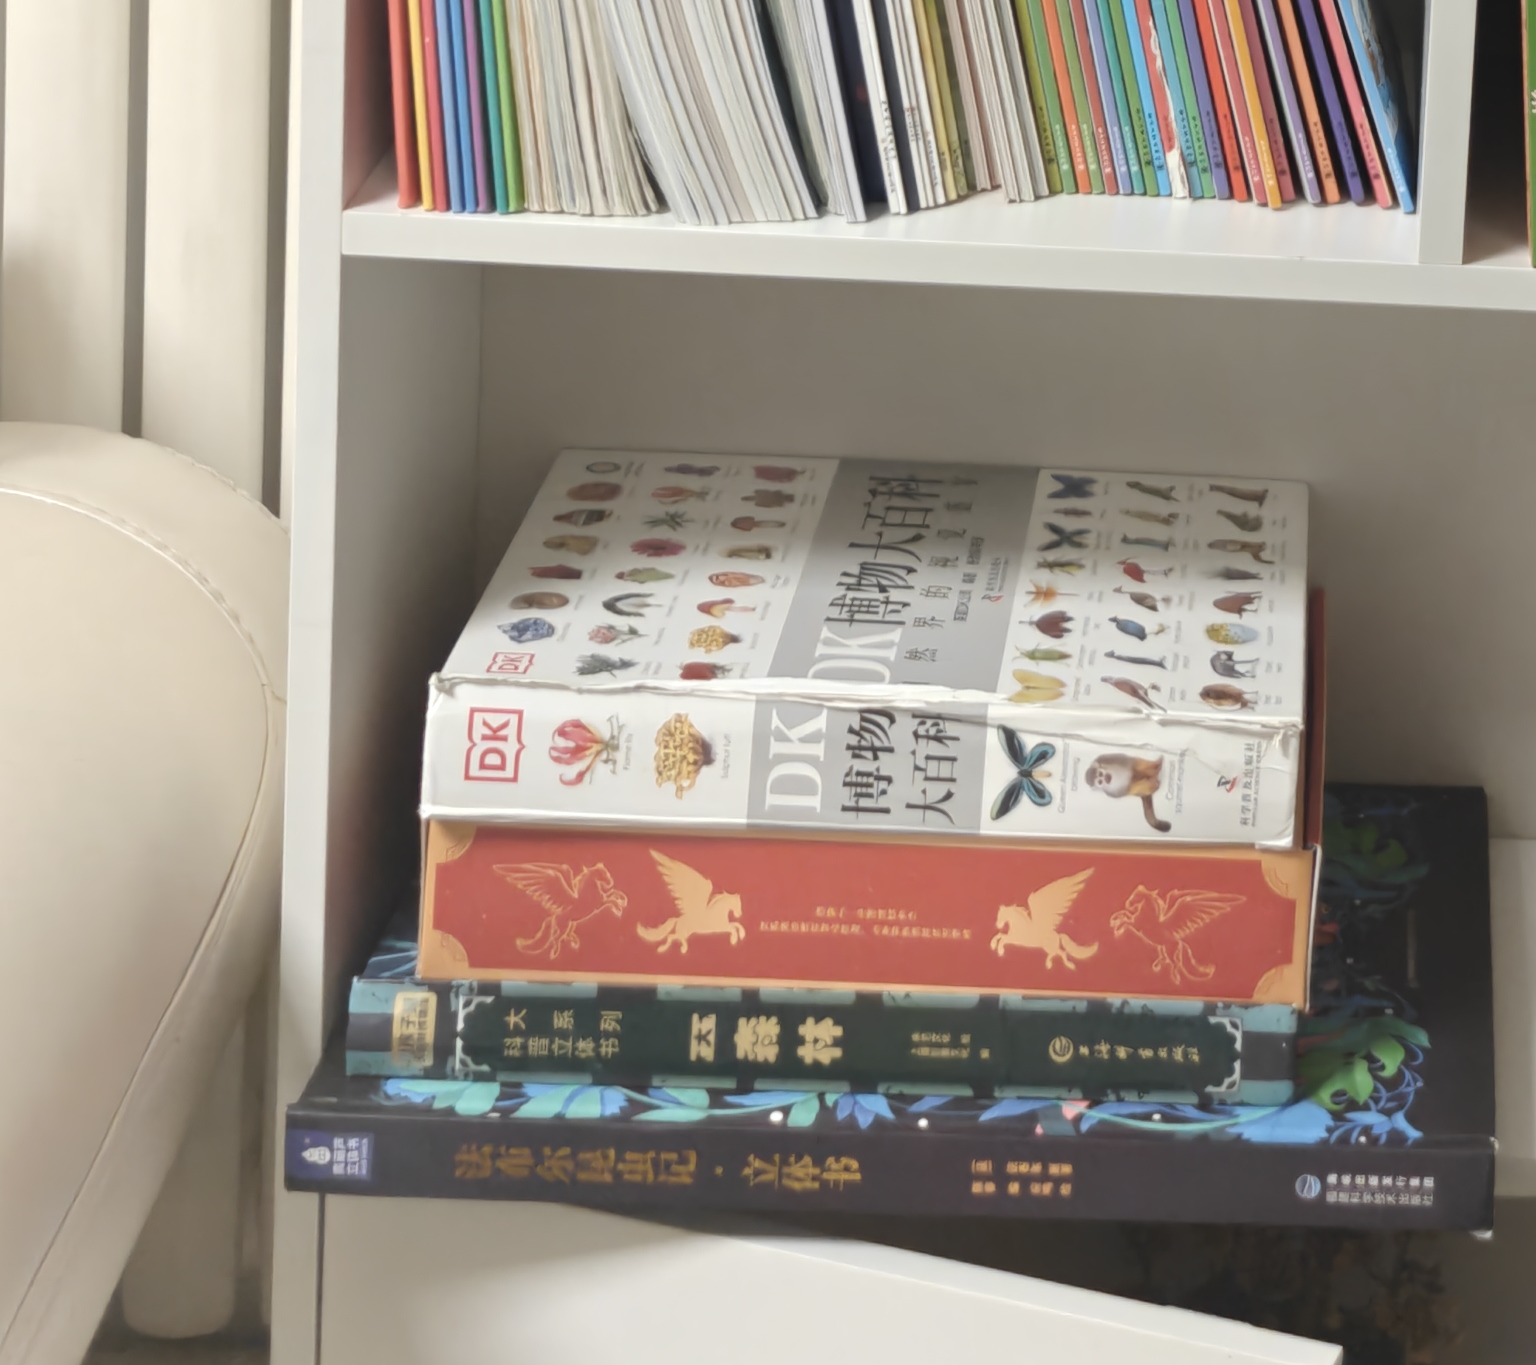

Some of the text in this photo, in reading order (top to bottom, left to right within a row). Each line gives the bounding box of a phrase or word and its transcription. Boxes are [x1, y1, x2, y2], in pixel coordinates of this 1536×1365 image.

[498, 654, 525, 671] DK
[478, 717, 511, 772] DK
[764, 707, 828, 813] DK
[841, 708, 897, 819] 博物
[905, 712, 961, 825] 大百科
[503, 1036, 620, 1059] 科普立体书
[504, 1008, 622, 1033] 大系列
[690, 1012, 844, 1066] 大森林
